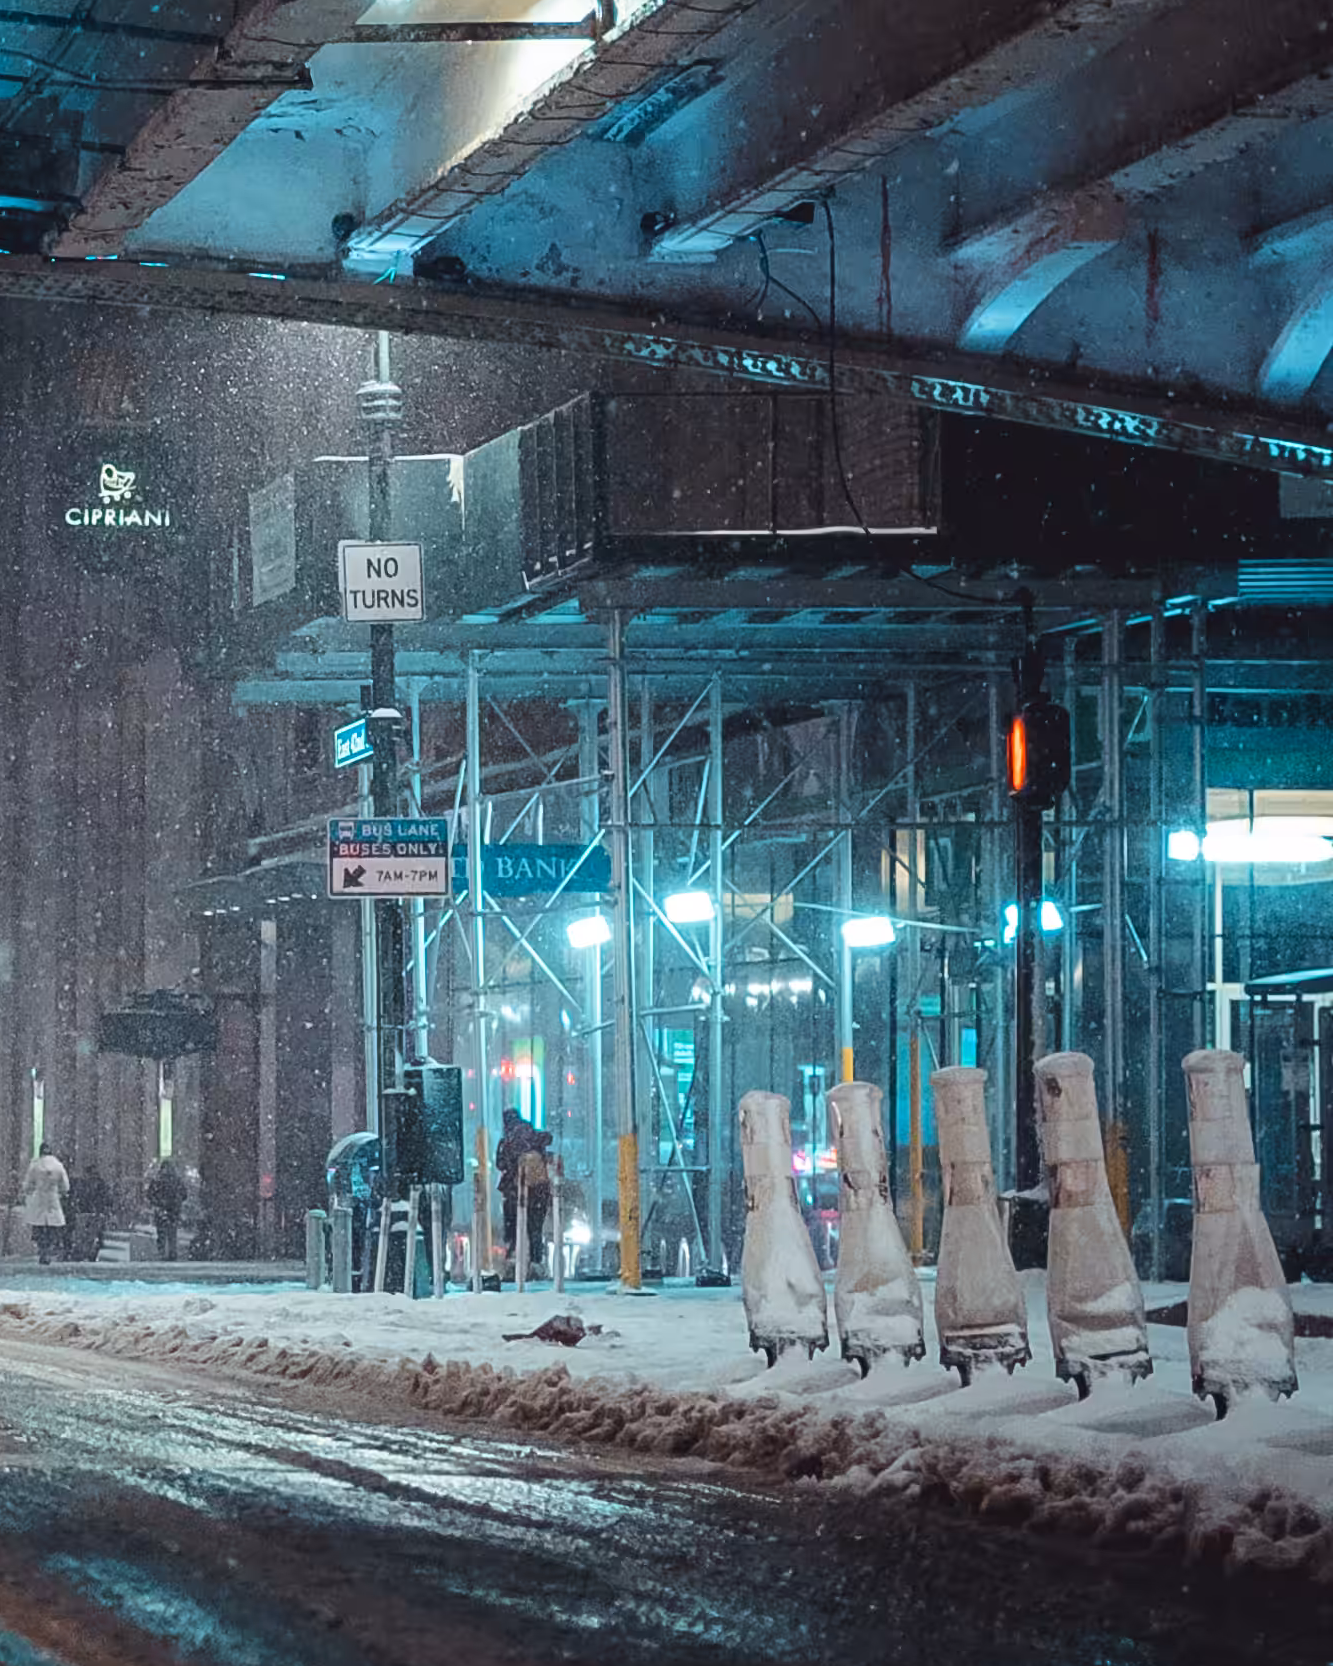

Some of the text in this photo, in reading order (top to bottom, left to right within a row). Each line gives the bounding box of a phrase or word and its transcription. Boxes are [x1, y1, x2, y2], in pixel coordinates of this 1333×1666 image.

[64, 507, 170, 527] CIPRIANI
[366, 557, 399, 579] NO
[349, 589, 419, 609] TURNS
[362, 823, 439, 836] BUS LANE
[339, 842, 438, 855] BUSES ONLY
[376, 869, 438, 882] 7AM-7PM
